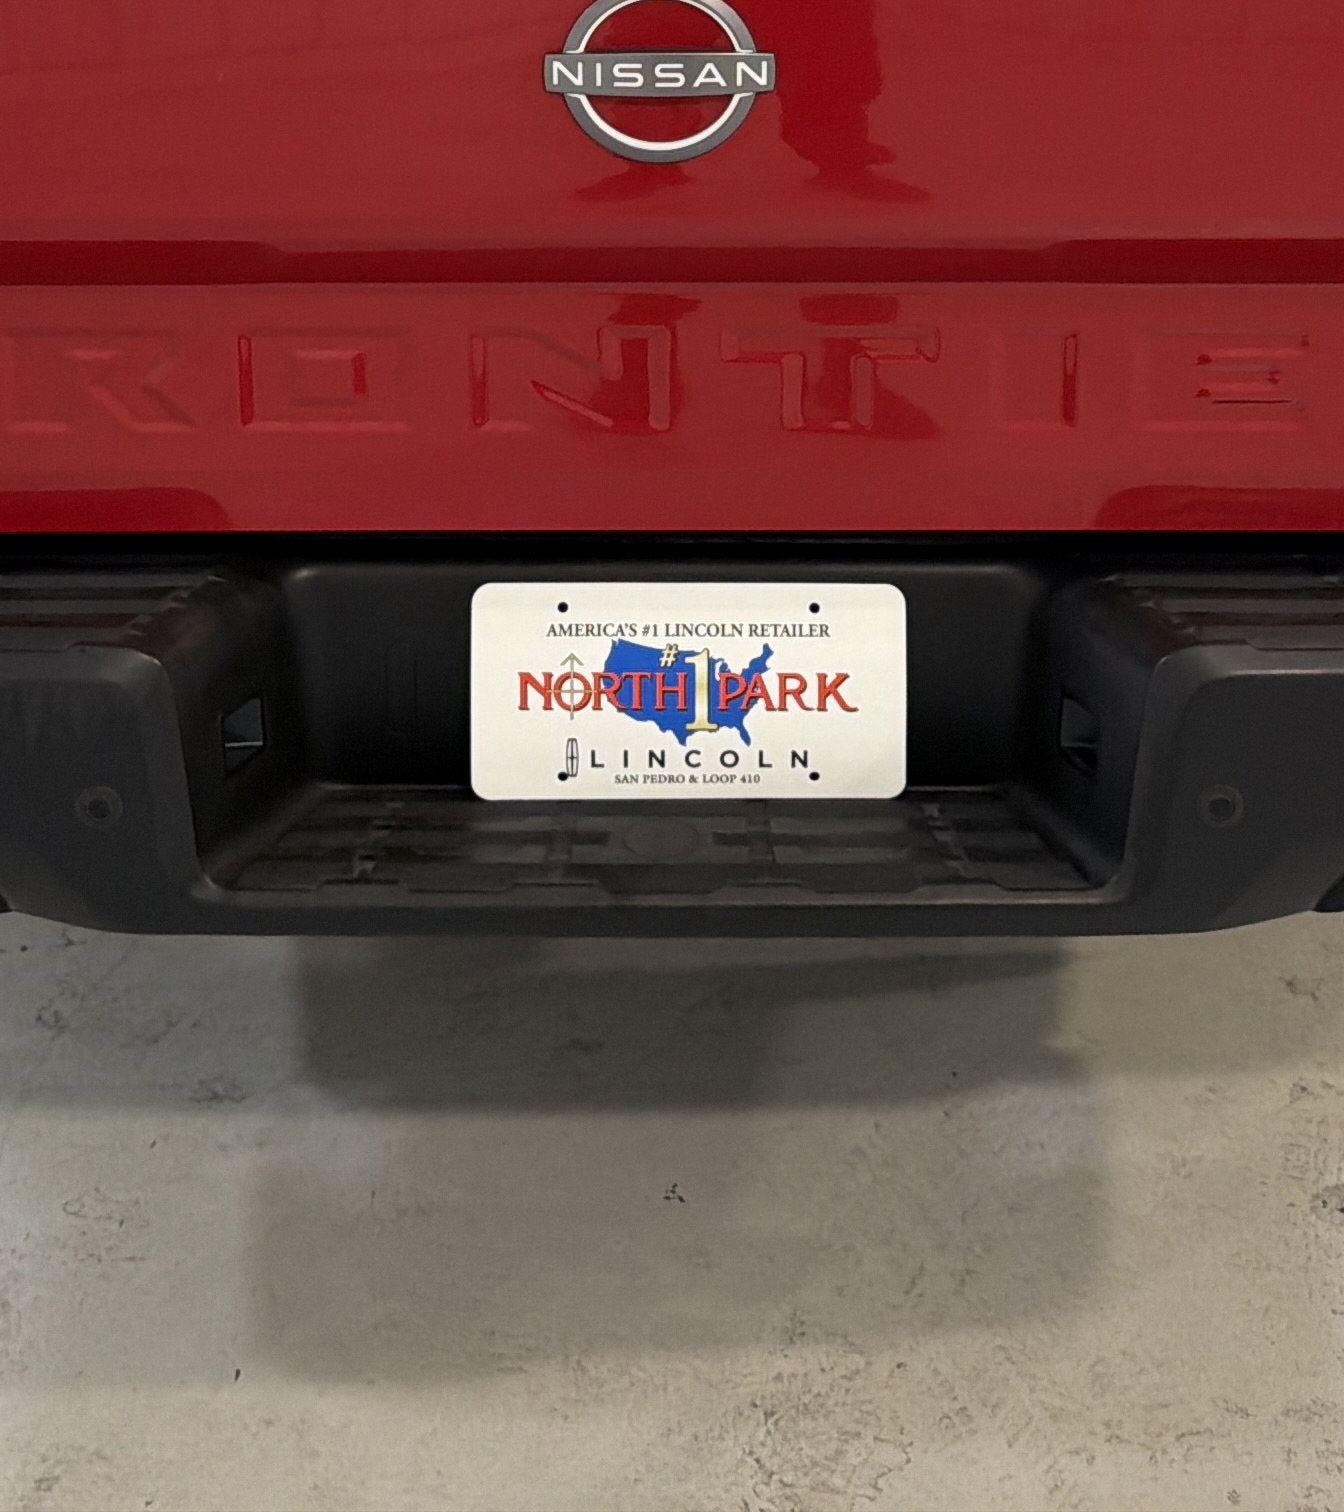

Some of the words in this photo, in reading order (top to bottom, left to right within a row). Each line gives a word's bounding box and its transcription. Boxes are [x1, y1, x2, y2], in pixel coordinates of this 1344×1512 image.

[552, 60, 768, 88] NISSAN
[546, 622, 637, 637] AMERICA'S
[642, 623, 659, 637] #1
[664, 623, 743, 637] LINCOLN
[748, 623, 831, 638] RETAILER
[518, 672, 687, 711] NORTH
[718, 672, 859, 712] PARK
[591, 749, 808, 768] LINCOLN
[614, 774, 639, 784] SAN
[643, 774, 685, 784] PEDRO
[689, 774, 698, 784] &
[702, 774, 736, 784] LOOP
[740, 774, 760, 784] 410
